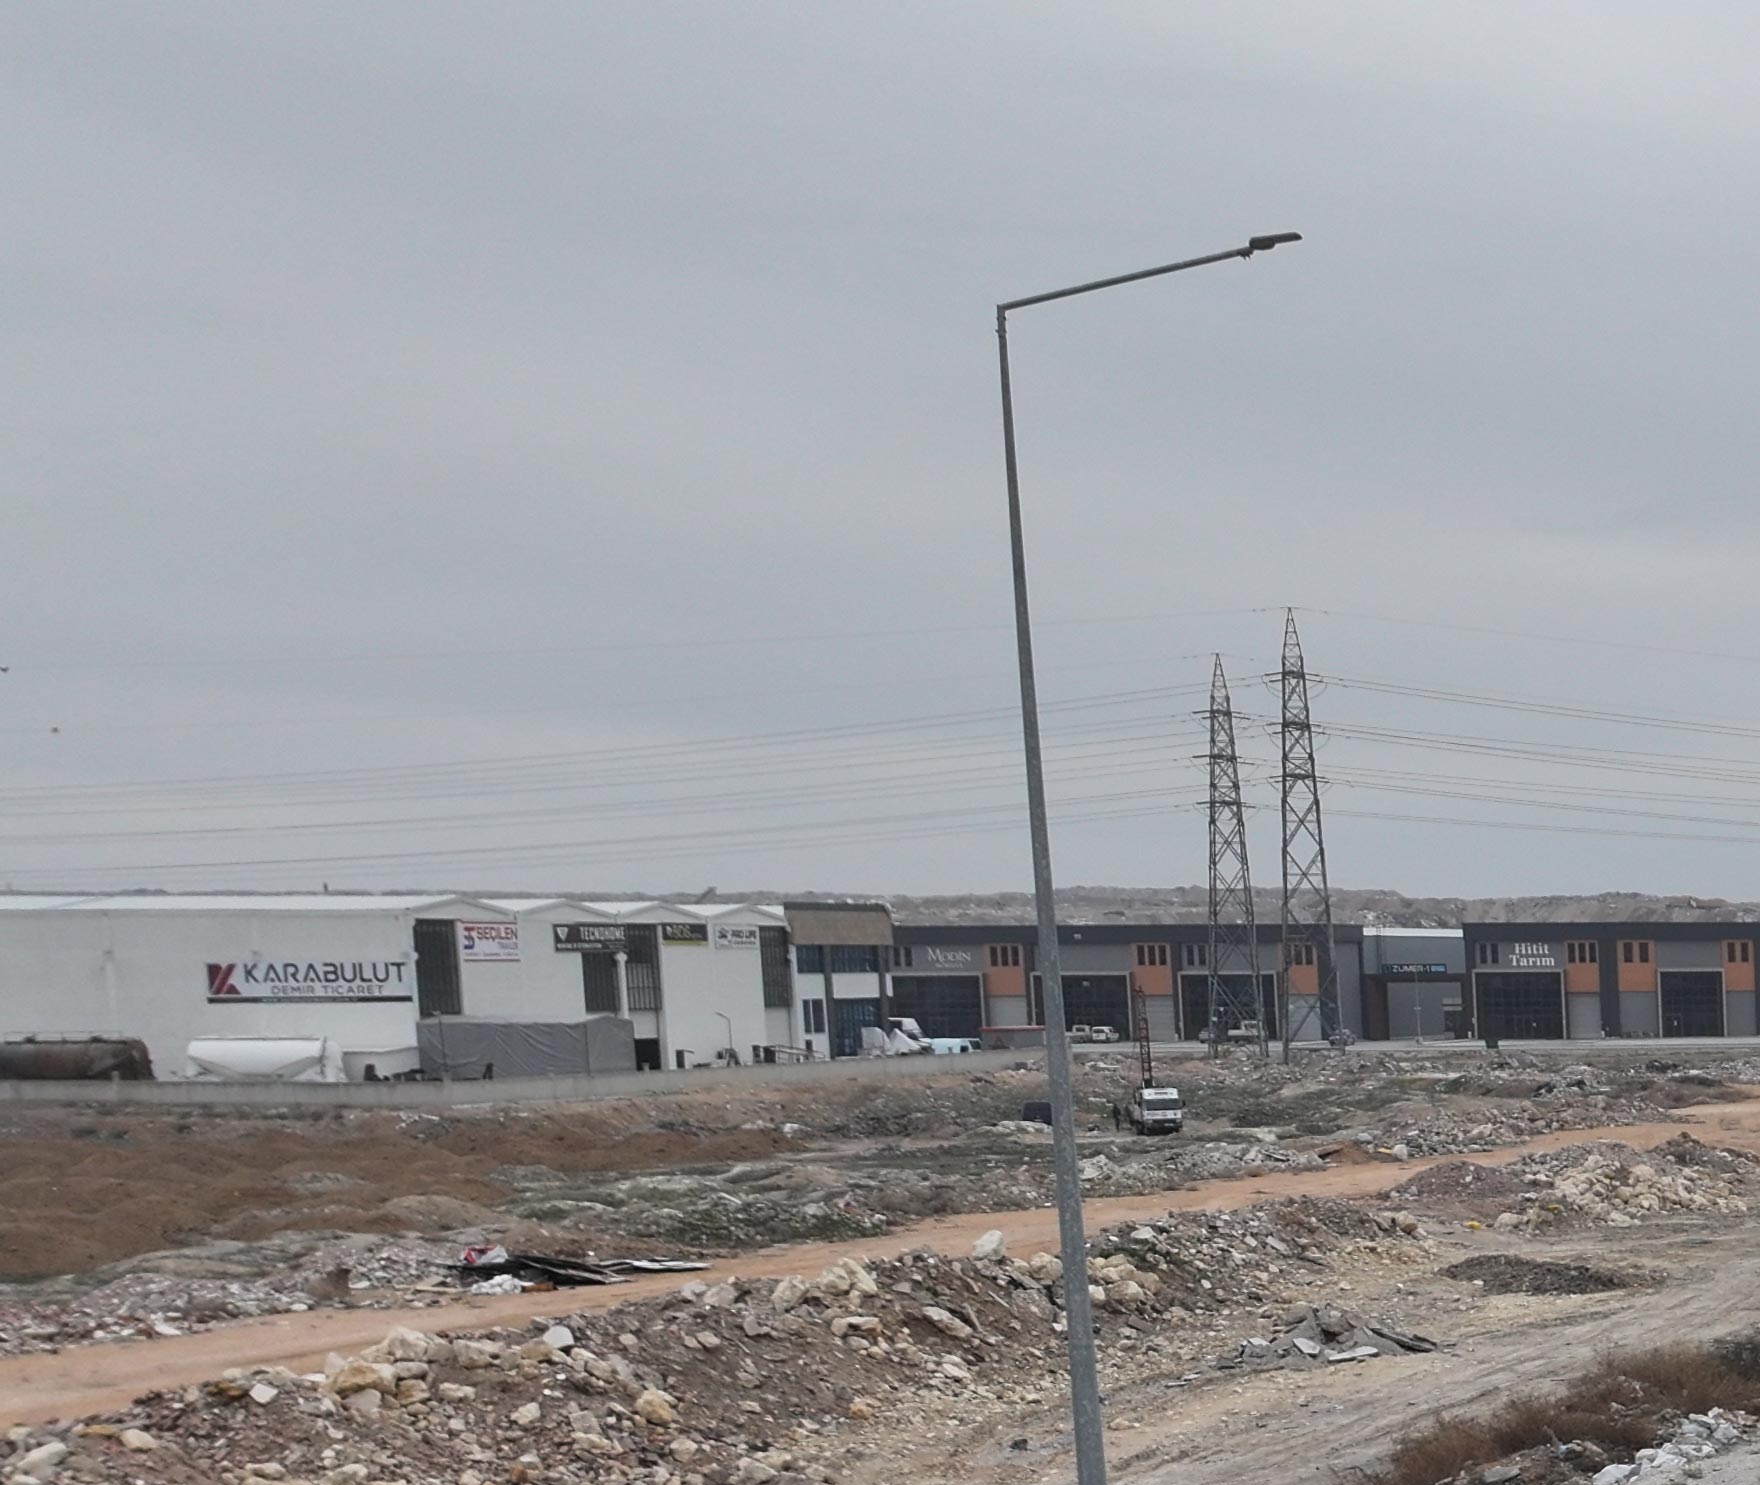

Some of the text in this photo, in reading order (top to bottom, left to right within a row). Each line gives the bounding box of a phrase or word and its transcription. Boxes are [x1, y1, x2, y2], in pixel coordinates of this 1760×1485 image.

[1514, 942, 1549, 954] Hitit
[1509, 954, 1555, 966] Tarım
[243, 963, 406, 983] KARABULUT
